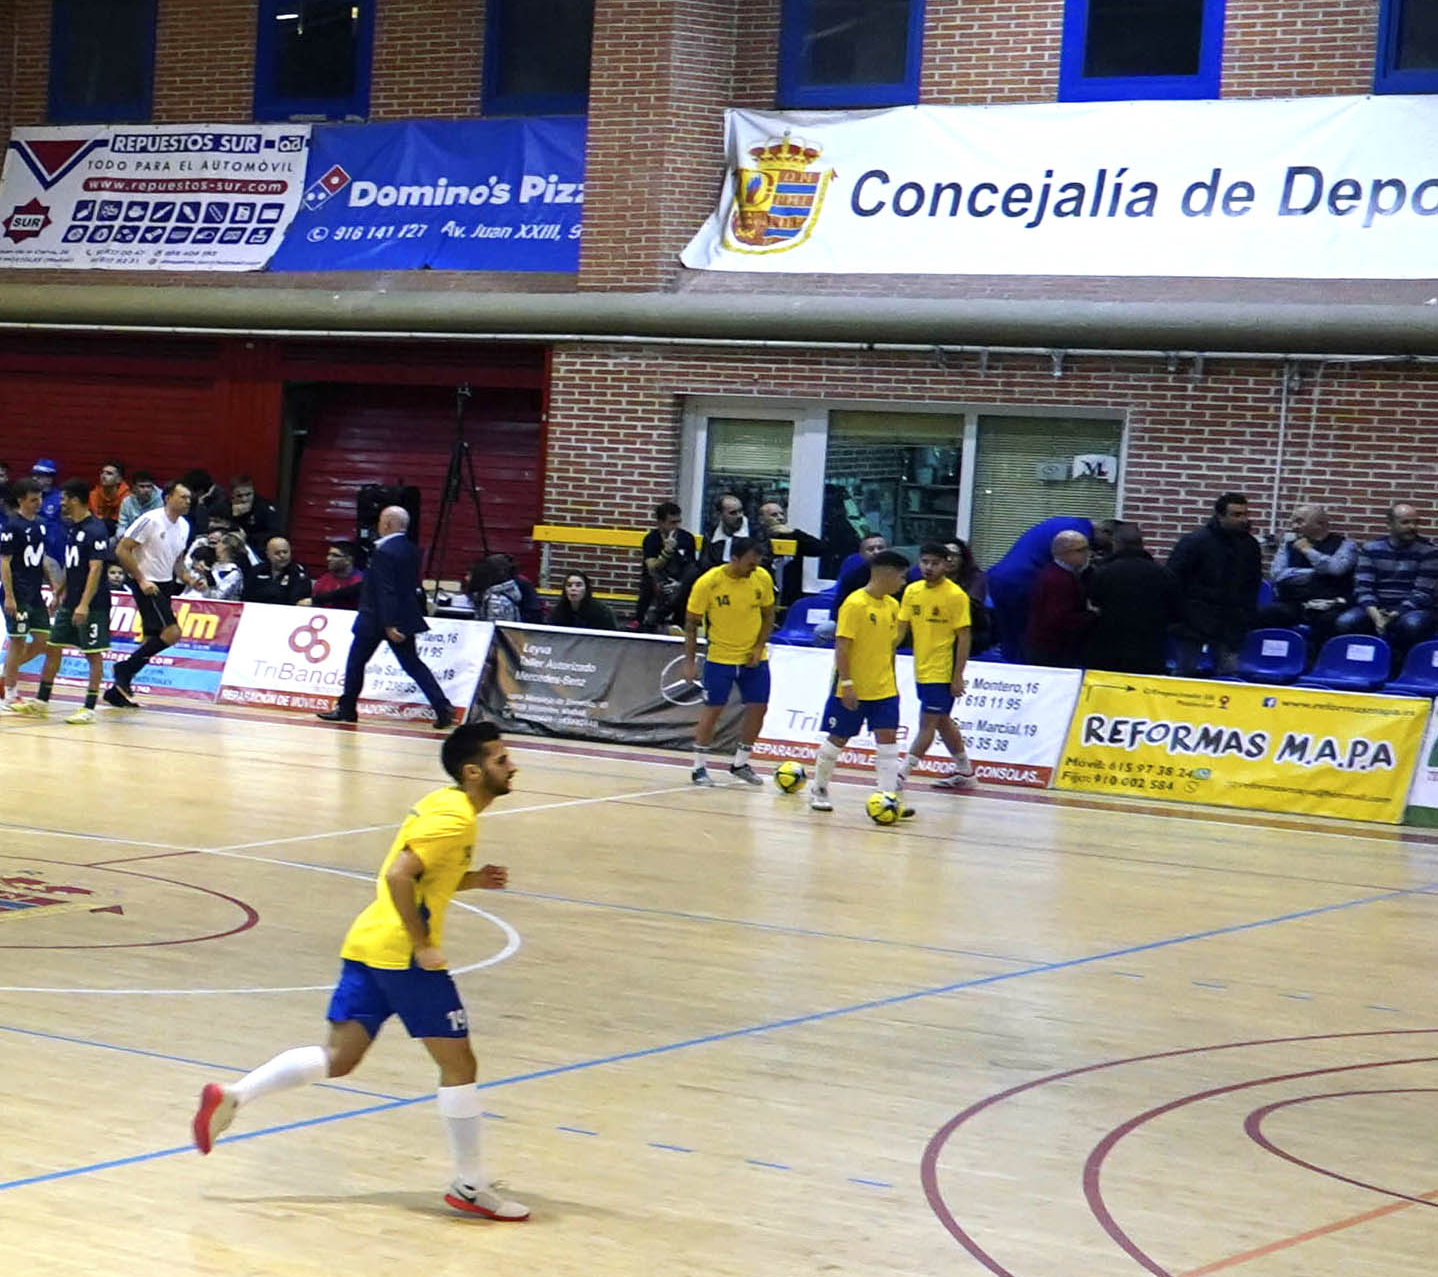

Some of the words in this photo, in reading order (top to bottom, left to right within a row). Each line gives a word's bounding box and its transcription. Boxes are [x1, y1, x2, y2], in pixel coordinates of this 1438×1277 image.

[113, 136, 215, 152] REPUESTOS
[219, 135, 257, 151] SUR
[88, 160, 127, 171] TODO
[135, 160, 171, 171] PARA
[179, 160, 193, 171] EL
[200, 158, 294, 172] AUTOMÓVIL
[88, 179, 282, 193] www.repuestos-sur.com
[348, 176, 511, 207] Domino's
[851, 167, 1159, 229] Concejalía
[1181, 167, 1256, 218] de
[13, 217, 41, 228] SUR
[333, 226, 364, 240] 916
[366, 225, 393, 239] 141
[441, 221, 465, 239] Av.
[470, 225, 512, 239] Juan
[89, 623, 98, 638] 3
[523, 642, 552, 655] Leyva
[973, 677, 1040, 694] Montero,16
[279, 694, 291, 707] DE
[964, 694, 987, 708] 618
[989, 696, 1004, 709] 11
[1005, 697, 1022, 711] 95
[976, 735, 994, 750] 35
[995, 737, 1008, 752] 38
[1084, 715, 1267, 759] REFORMAS
[1278, 734, 1393, 771] M.A.P.A
[1065, 756, 1107, 770] Móvil:
[1108, 760, 1133, 773] 615
[1136, 763, 1153, 775] 97
[1177, 766, 1193, 779] 24
[1093, 774, 1116, 787] 910
[1121, 776, 1146, 789] 002
[1150, 778, 1174, 791] 584
